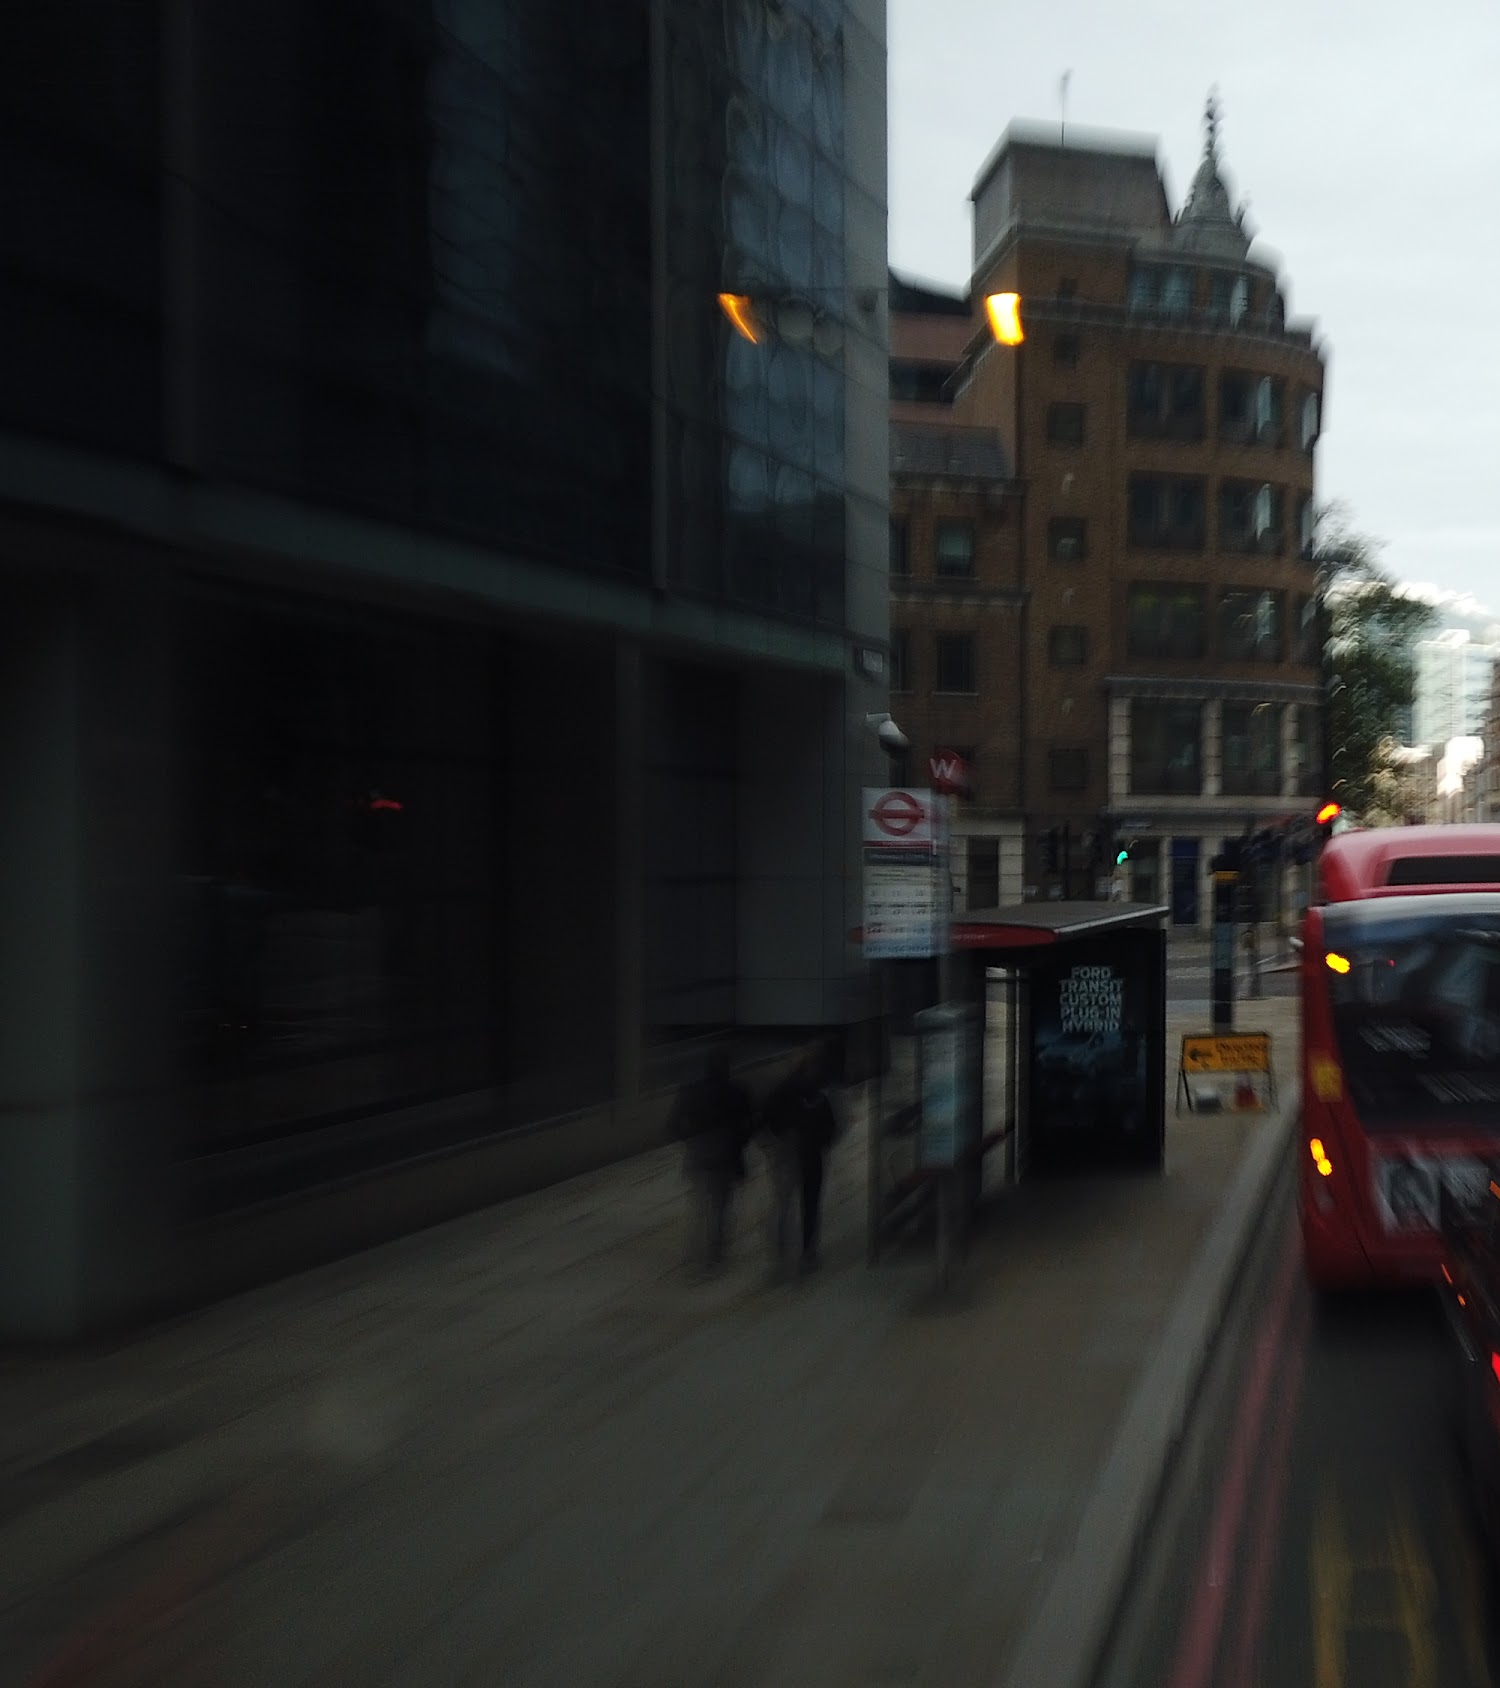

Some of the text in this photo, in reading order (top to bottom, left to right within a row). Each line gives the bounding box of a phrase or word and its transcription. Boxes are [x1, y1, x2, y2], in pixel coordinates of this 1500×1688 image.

[930, 758, 956, 779] W
[1071, 966, 1111, 979] FORD
[1059, 979, 1123, 992] TRANSIT
[1060, 993, 1121, 1006] CUSTOM
[1060, 1006, 1120, 1019] PLUG-IN
[1062, 1020, 1119, 1033] HYBRID
